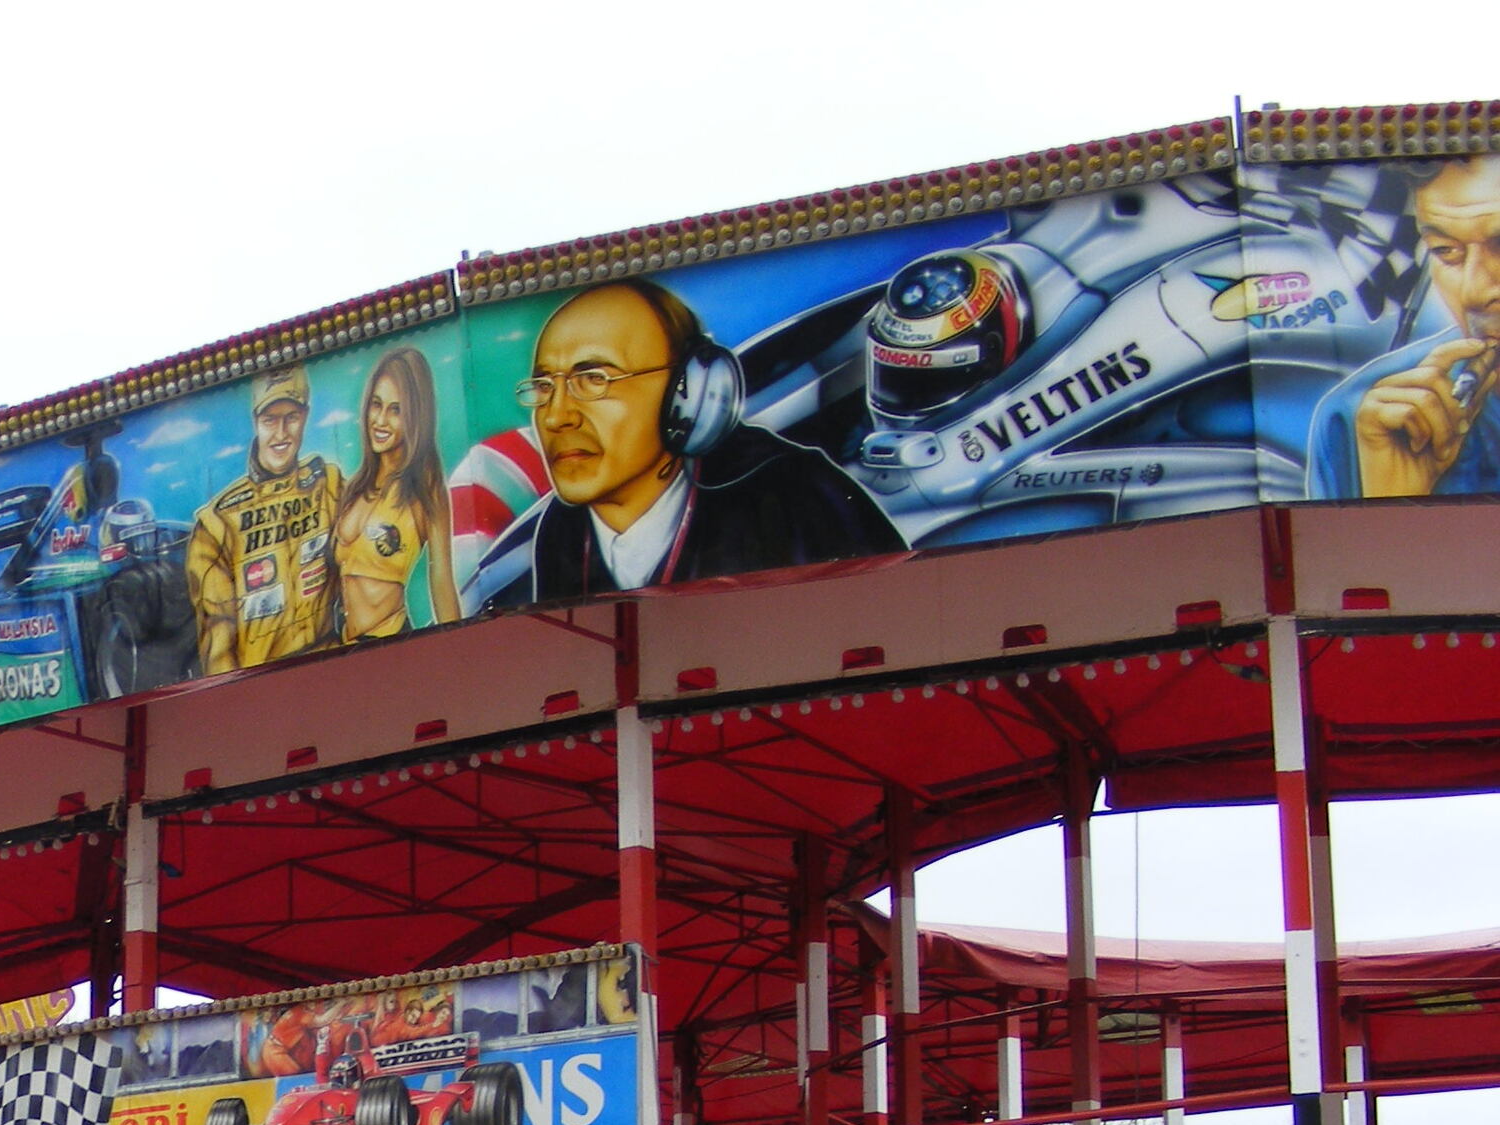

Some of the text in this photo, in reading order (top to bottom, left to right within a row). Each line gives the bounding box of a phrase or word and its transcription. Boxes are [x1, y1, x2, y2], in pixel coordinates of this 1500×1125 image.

[873, 346, 933, 368] COMPAQ
[974, 342, 1152, 453] VELTINS
[1014, 466, 1133, 488] REUTERS
[240, 495, 313, 533] BENSON
[244, 512, 320, 555] HEDGES
